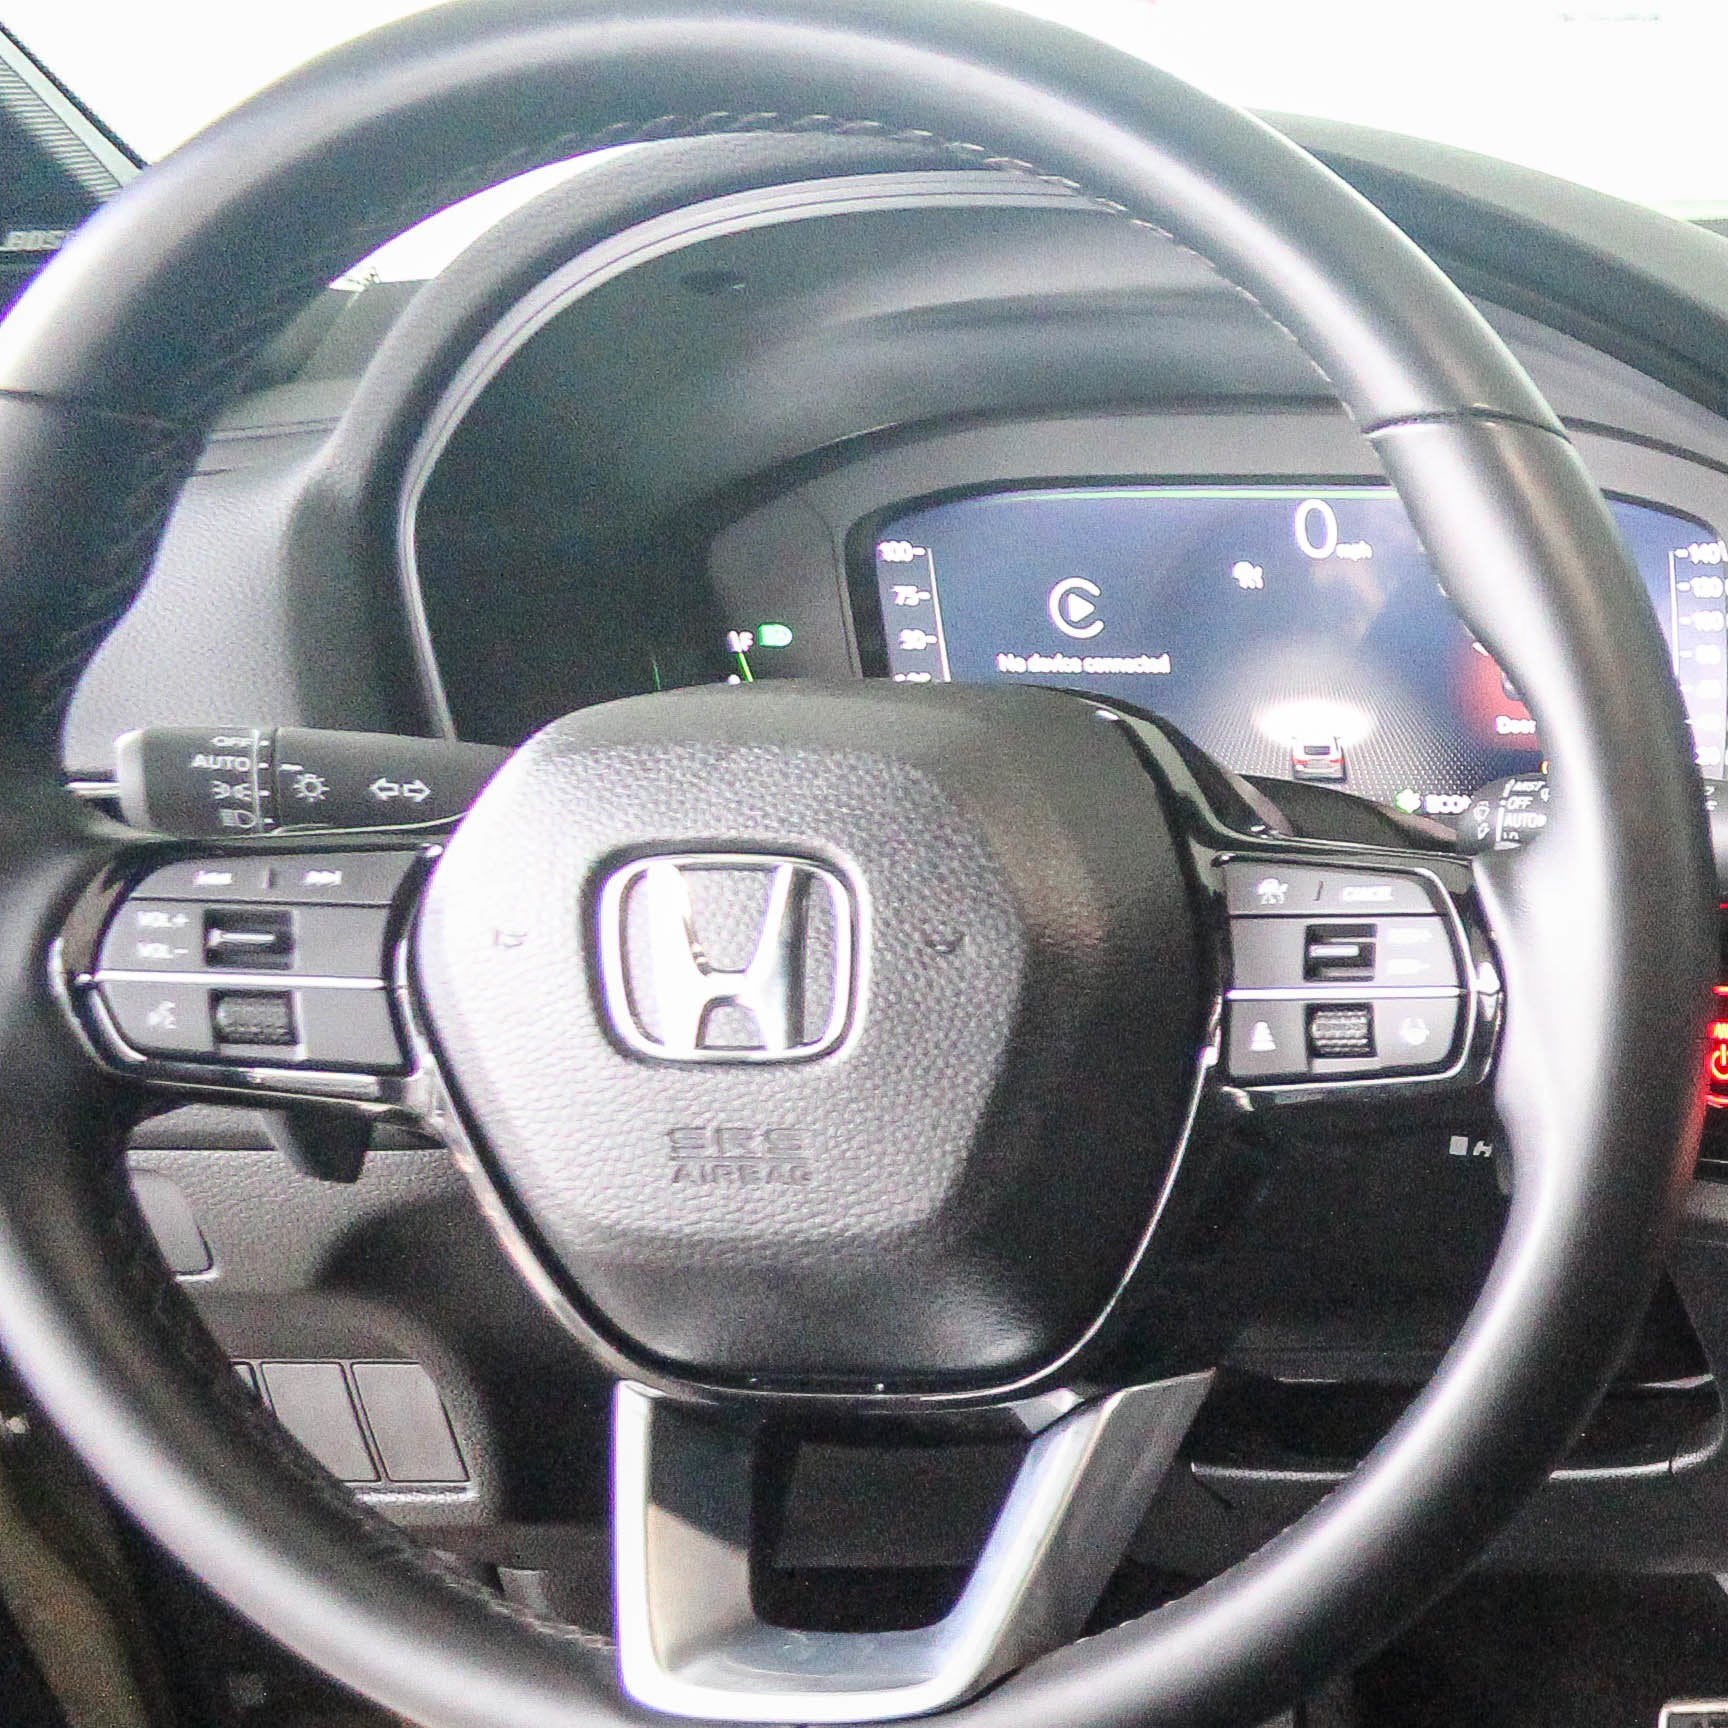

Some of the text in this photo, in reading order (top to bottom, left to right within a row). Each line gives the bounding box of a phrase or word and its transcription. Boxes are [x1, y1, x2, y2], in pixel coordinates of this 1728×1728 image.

[1294, 499, 1338, 559] 0
[1027, 652, 1082, 674] device
[1083, 653, 1171, 674] connected
[192, 753, 250, 773] AUTO
[1508, 796, 1533, 809] OFF
